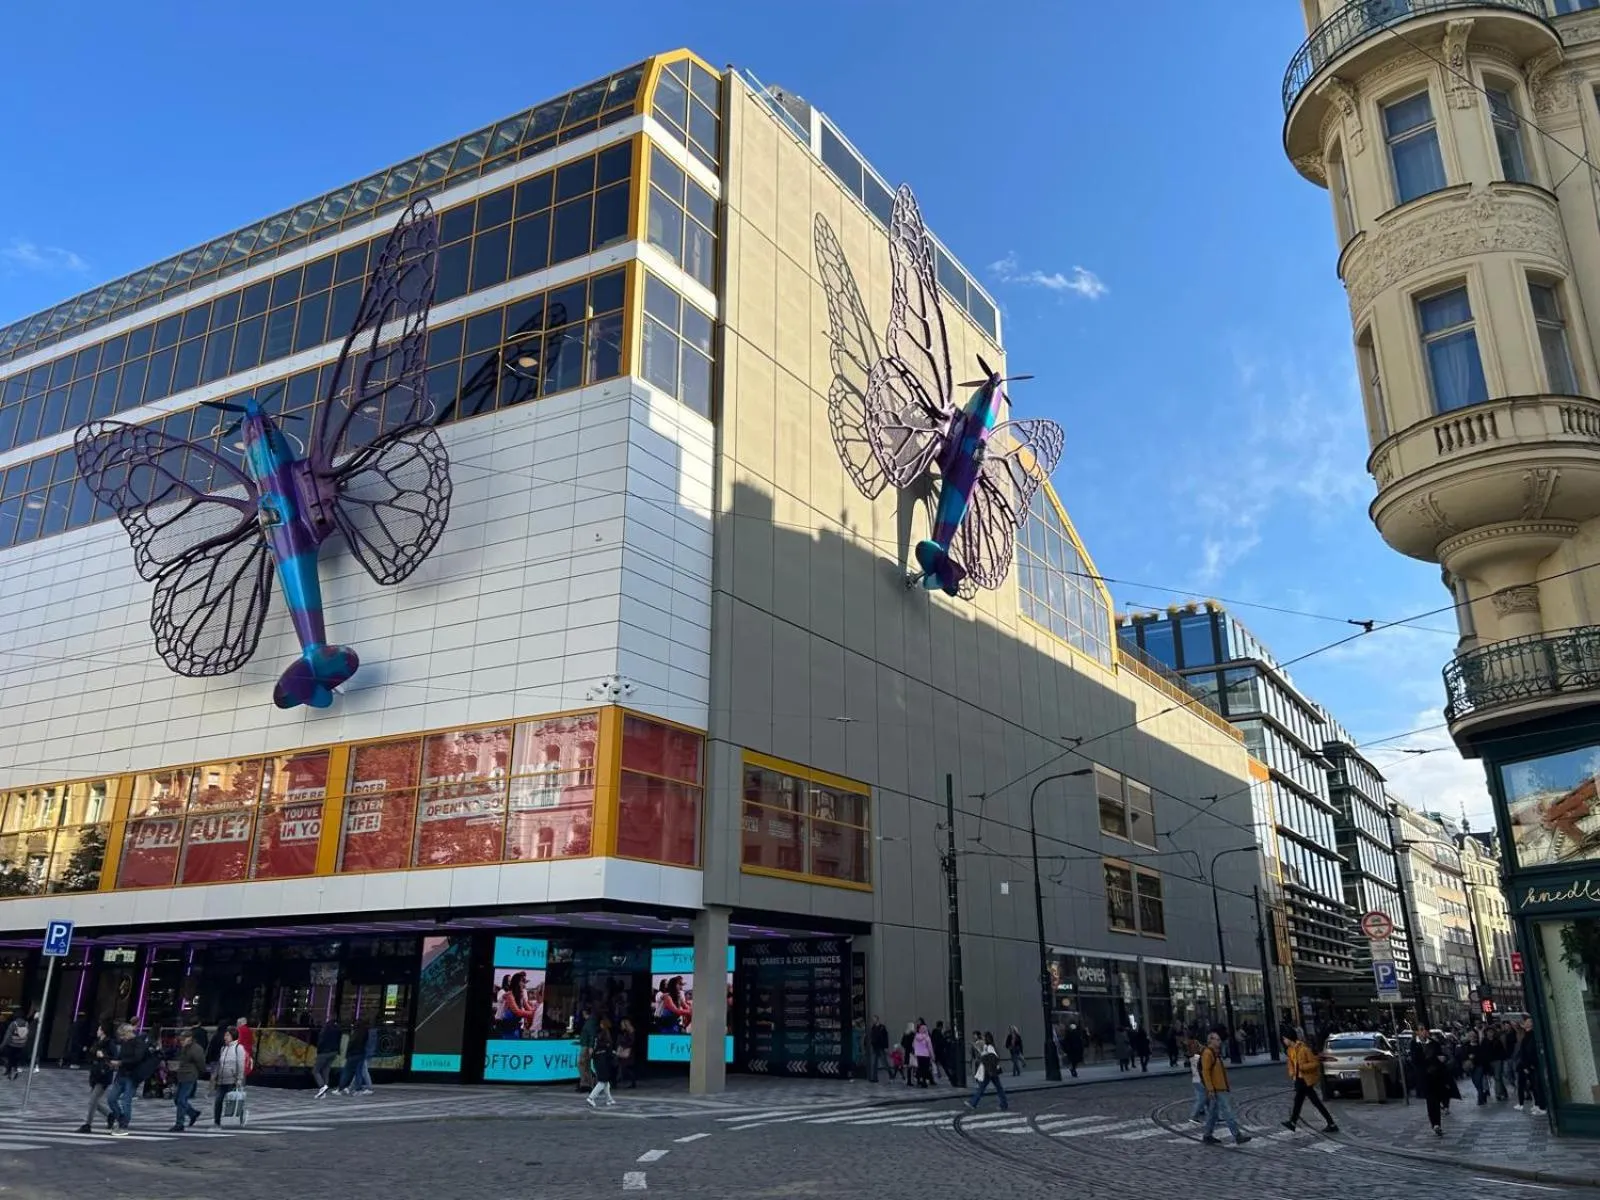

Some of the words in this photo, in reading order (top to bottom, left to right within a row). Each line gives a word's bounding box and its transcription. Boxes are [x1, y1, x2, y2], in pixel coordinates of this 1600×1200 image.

[284, 806, 319, 819] YOU'VE
[280, 823, 297, 839] IN
[51, 924, 67, 945] P
[759, 956, 785, 965] GAMES
[793, 955, 841, 966] EXPERIENCES
[1378, 965, 1392, 983] P
